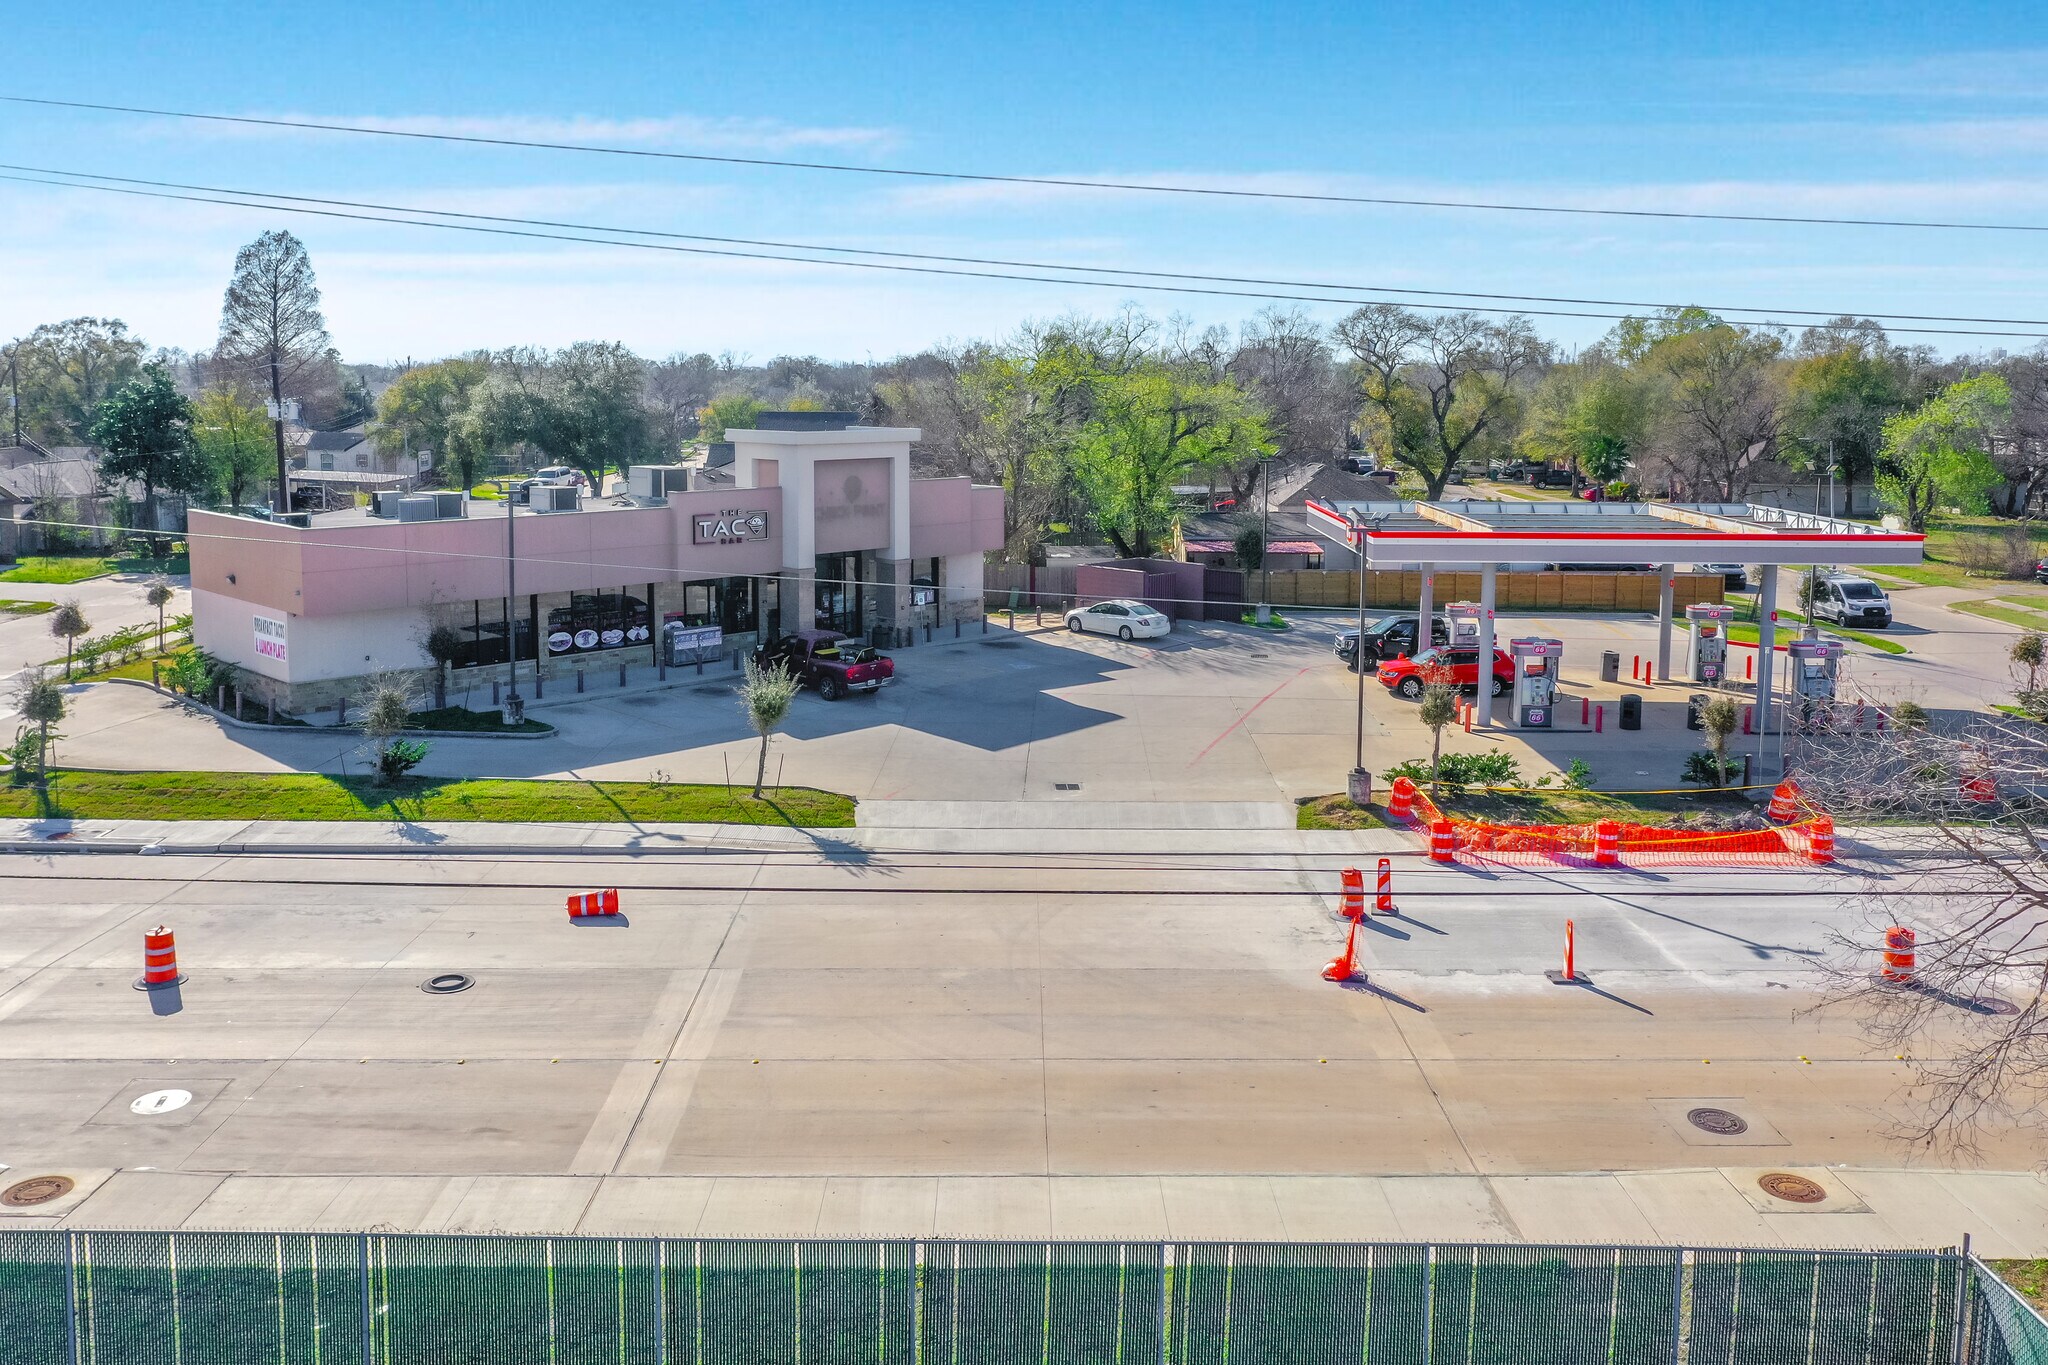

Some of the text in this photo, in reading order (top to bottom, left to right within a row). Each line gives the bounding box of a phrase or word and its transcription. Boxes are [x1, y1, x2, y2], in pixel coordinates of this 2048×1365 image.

[720, 537, 742, 545] BAR
[254, 616, 285, 640] BREAKFAST TACOS
[259, 638, 273, 657] LUNCH
[273, 642, 286, 661] PLATE
